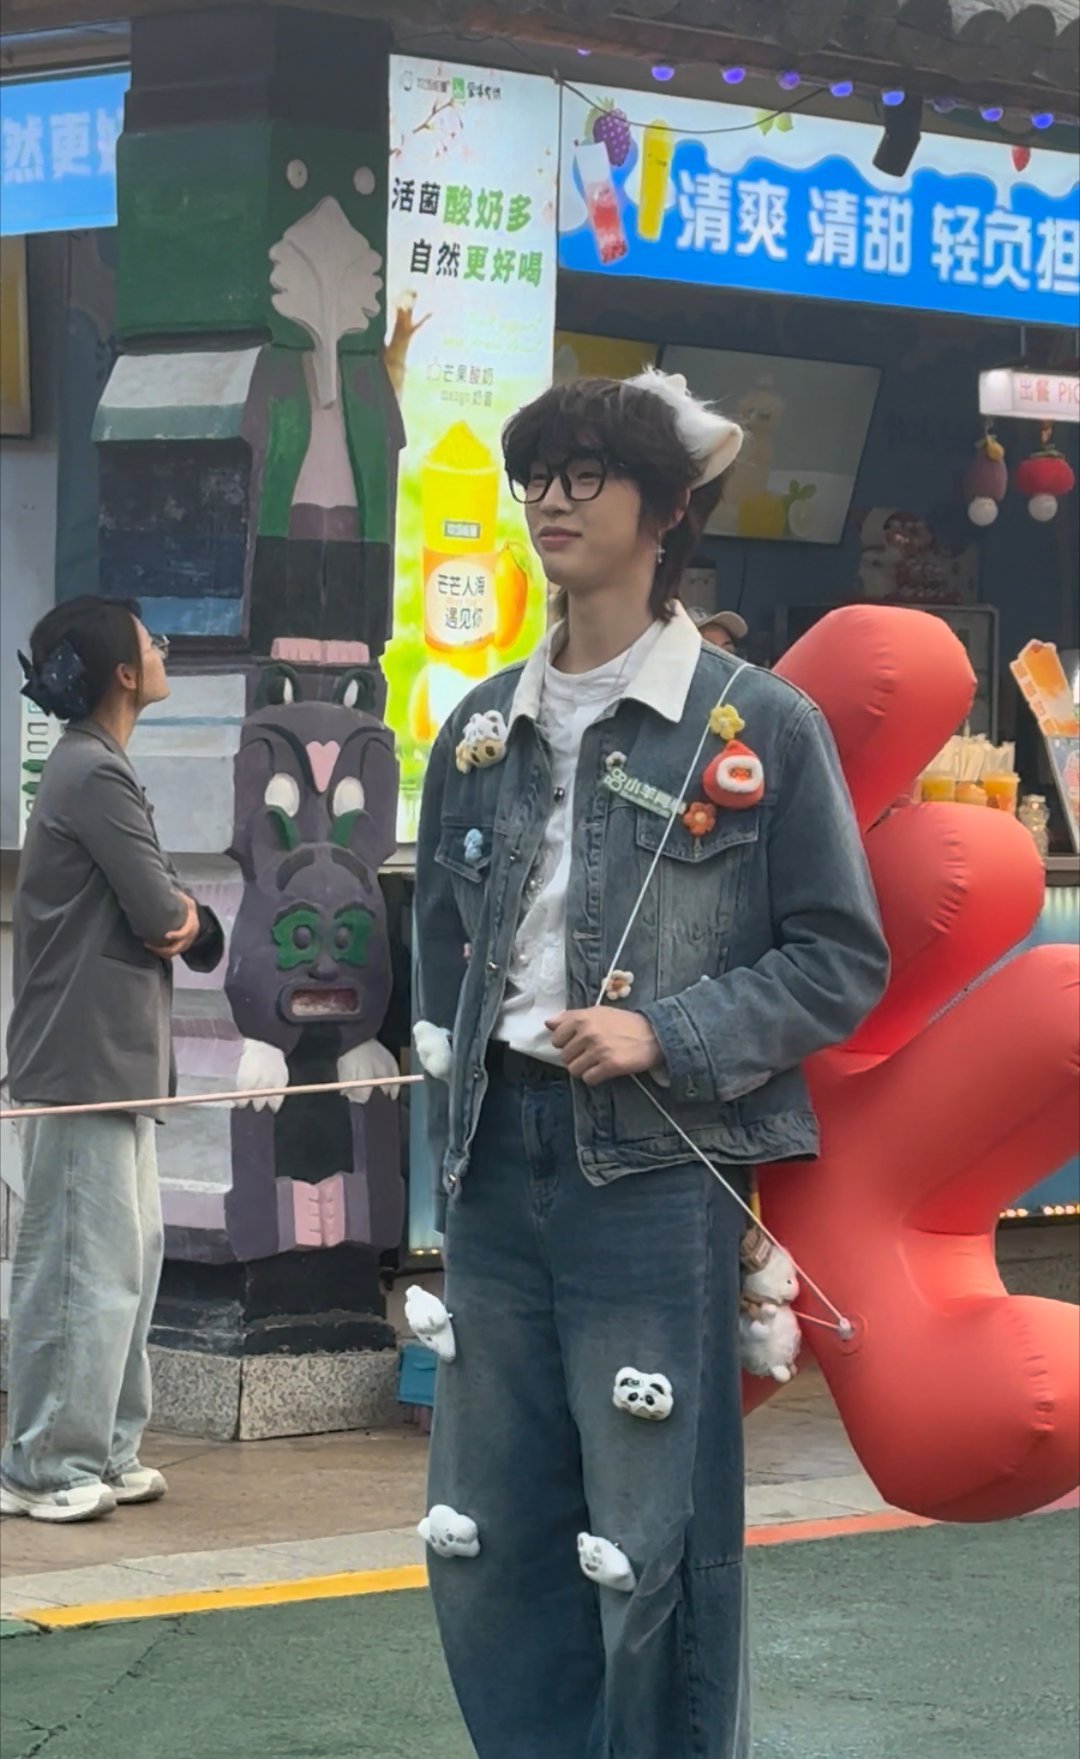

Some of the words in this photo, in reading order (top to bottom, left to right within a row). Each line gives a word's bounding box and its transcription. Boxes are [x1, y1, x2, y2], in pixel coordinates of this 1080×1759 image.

[391, 176, 533, 232] 活菌酸奶多
[675, 170, 789, 260] 清爽
[805, 186, 913, 276] 清甜
[931, 202, 1080, 294] 轻负担
[410, 238, 543, 287] 自然更好喝
